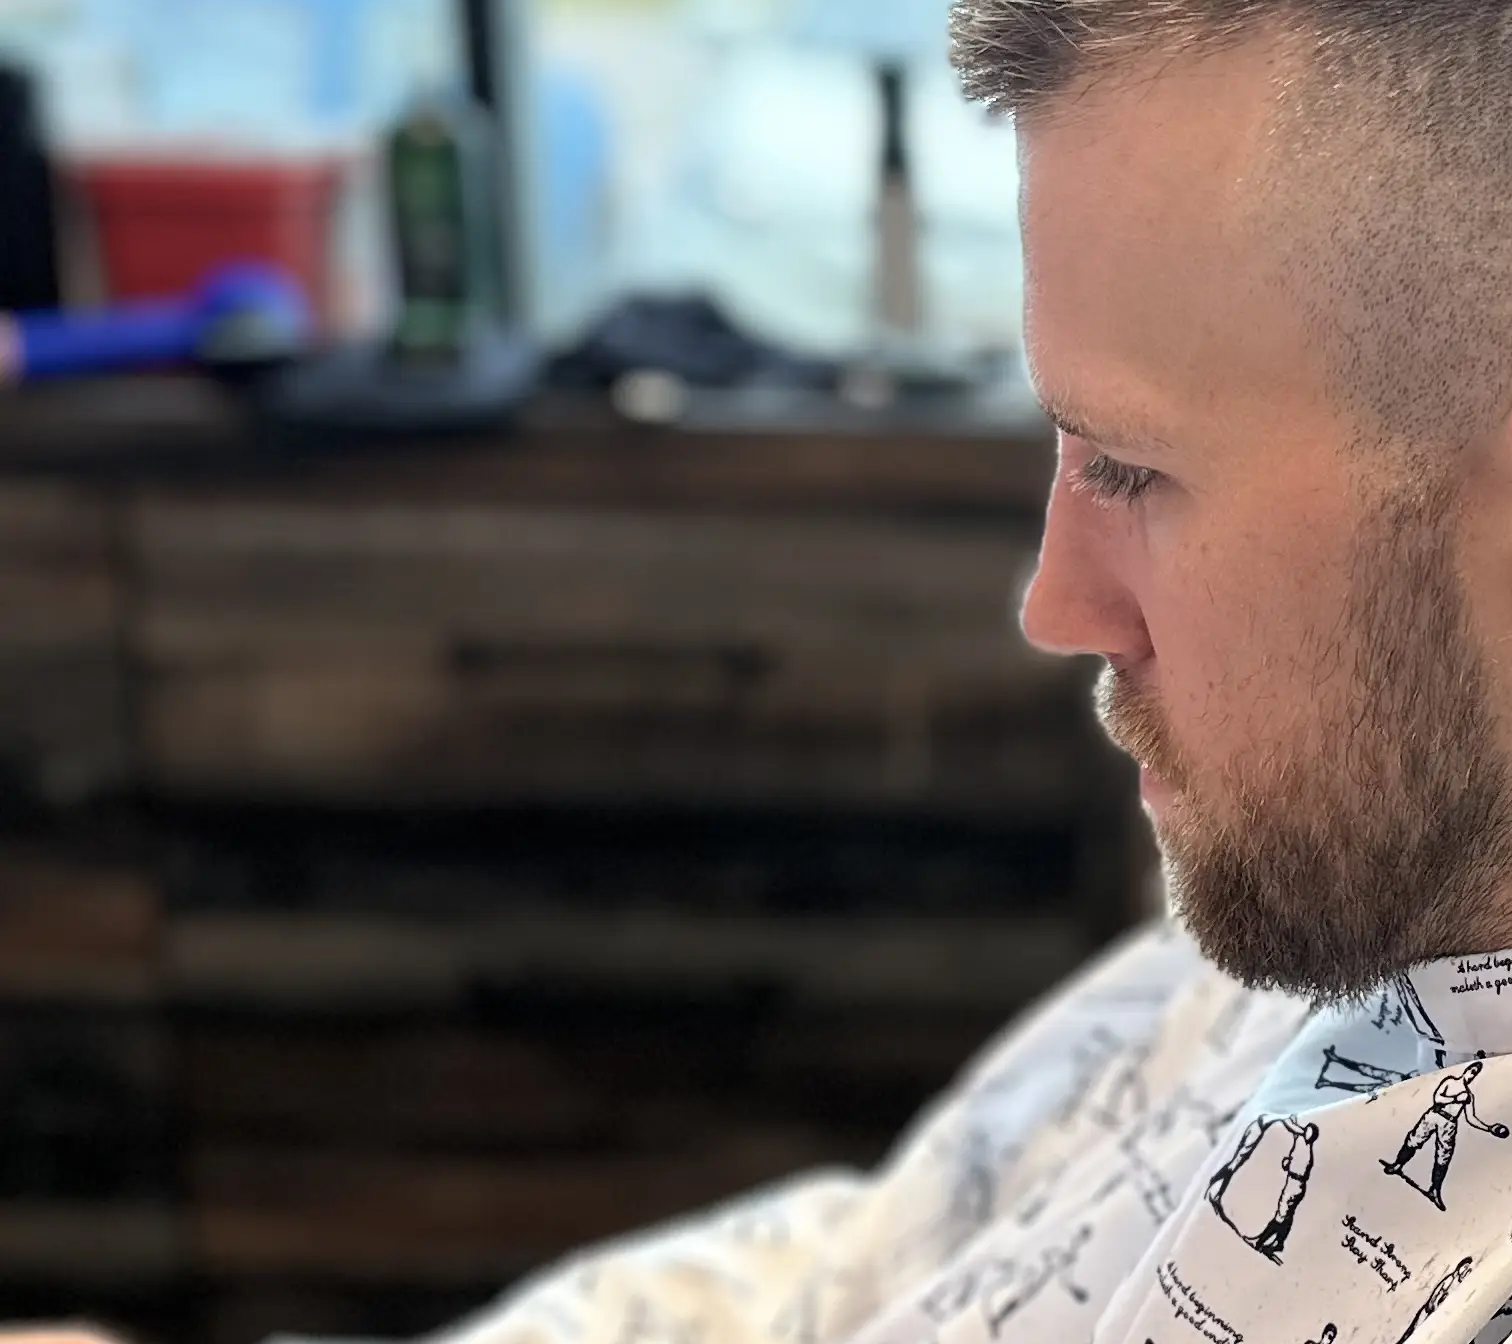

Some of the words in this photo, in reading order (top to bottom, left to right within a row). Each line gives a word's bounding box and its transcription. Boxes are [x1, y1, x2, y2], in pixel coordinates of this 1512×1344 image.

[1466, 955, 1493, 974] hard
[1485, 980, 1494, 989] a
[1369, 1256, 1399, 1294] Sharp
[1174, 1305, 1207, 1331] good
[1188, 1291, 1244, 1344] beginning
